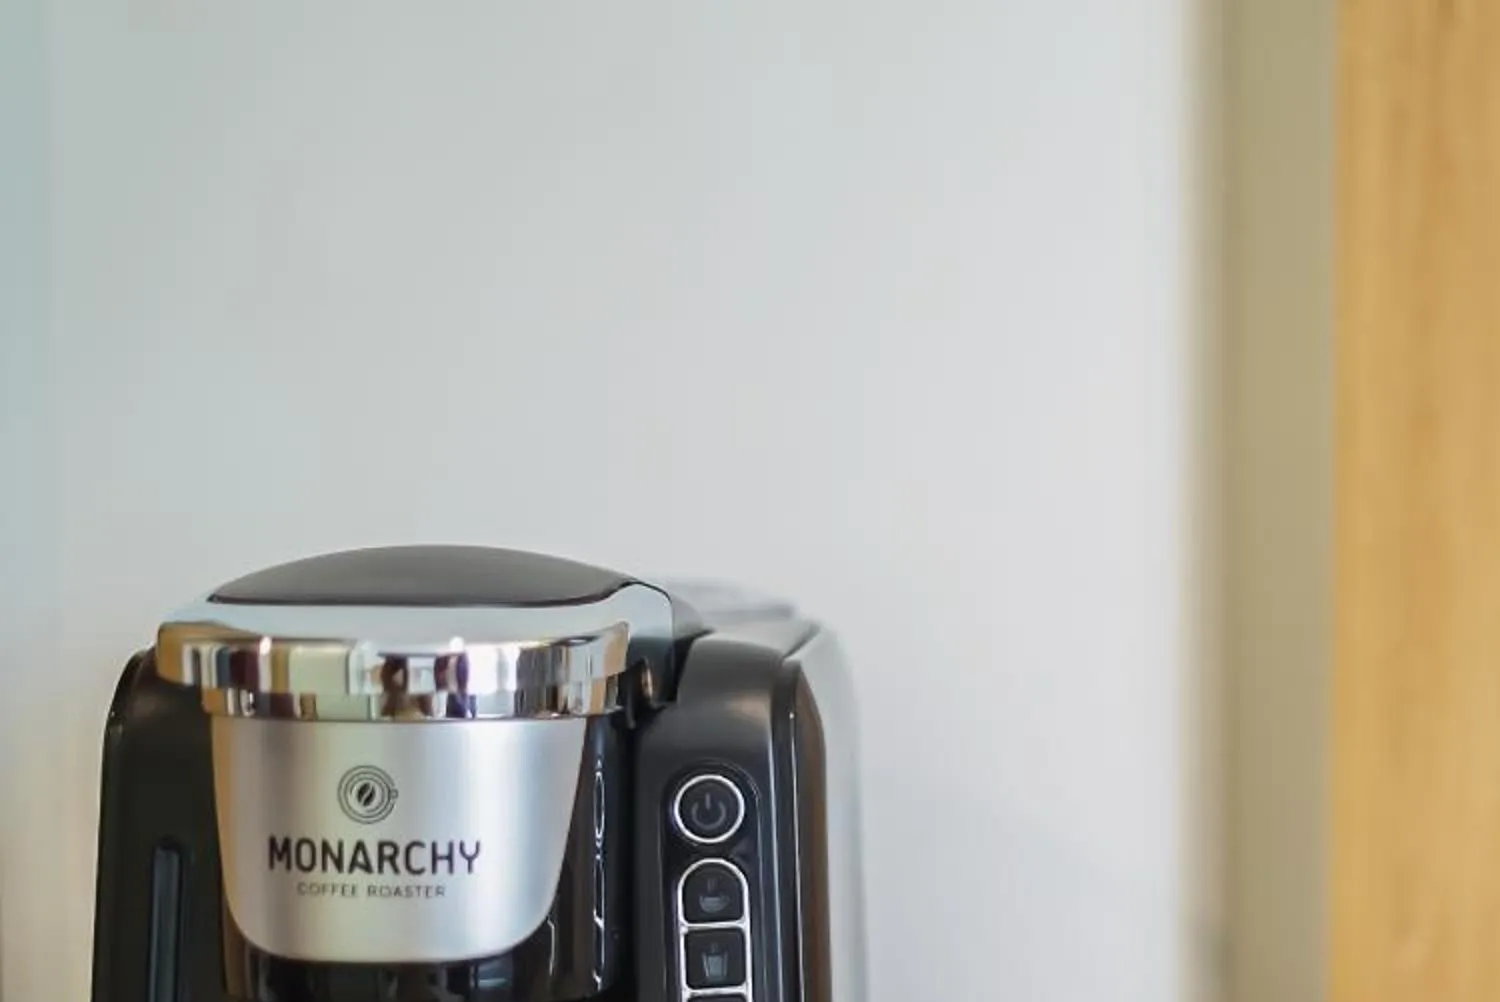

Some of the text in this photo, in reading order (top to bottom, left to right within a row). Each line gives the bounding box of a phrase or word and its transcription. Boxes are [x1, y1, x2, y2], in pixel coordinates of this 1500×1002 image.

[267, 835, 482, 876] MONARCHY
[296, 882, 446, 899] COFFEE ROASTER
